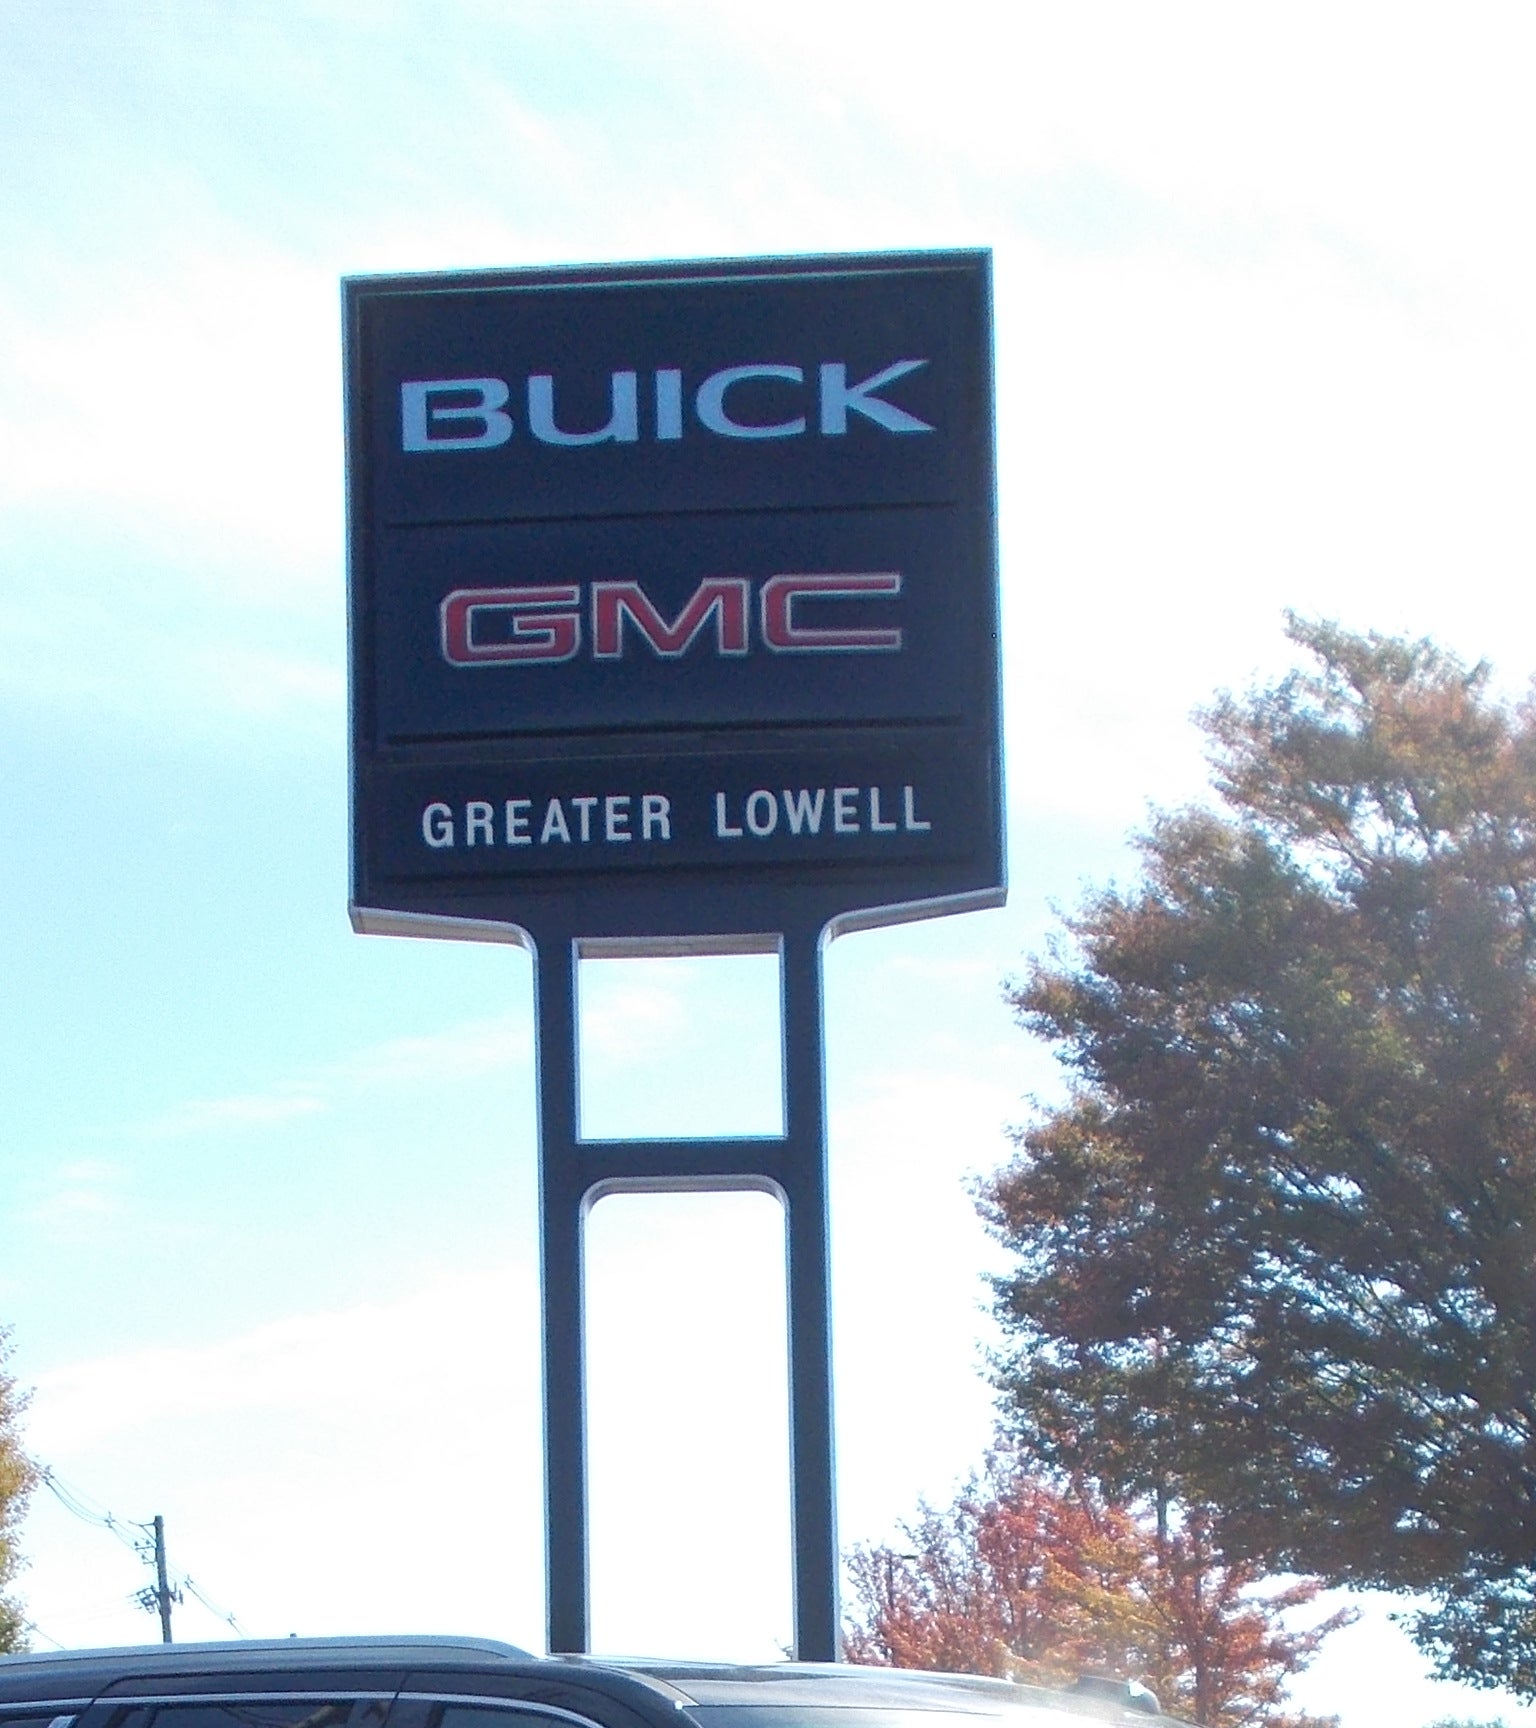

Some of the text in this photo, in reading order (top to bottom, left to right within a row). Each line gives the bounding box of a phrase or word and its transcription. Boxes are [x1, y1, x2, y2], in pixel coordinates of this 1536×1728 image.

[400, 359, 936, 453] BUICK
[440, 572, 902, 666] GMC
[422, 785, 932, 848] GREATER LOWELL
